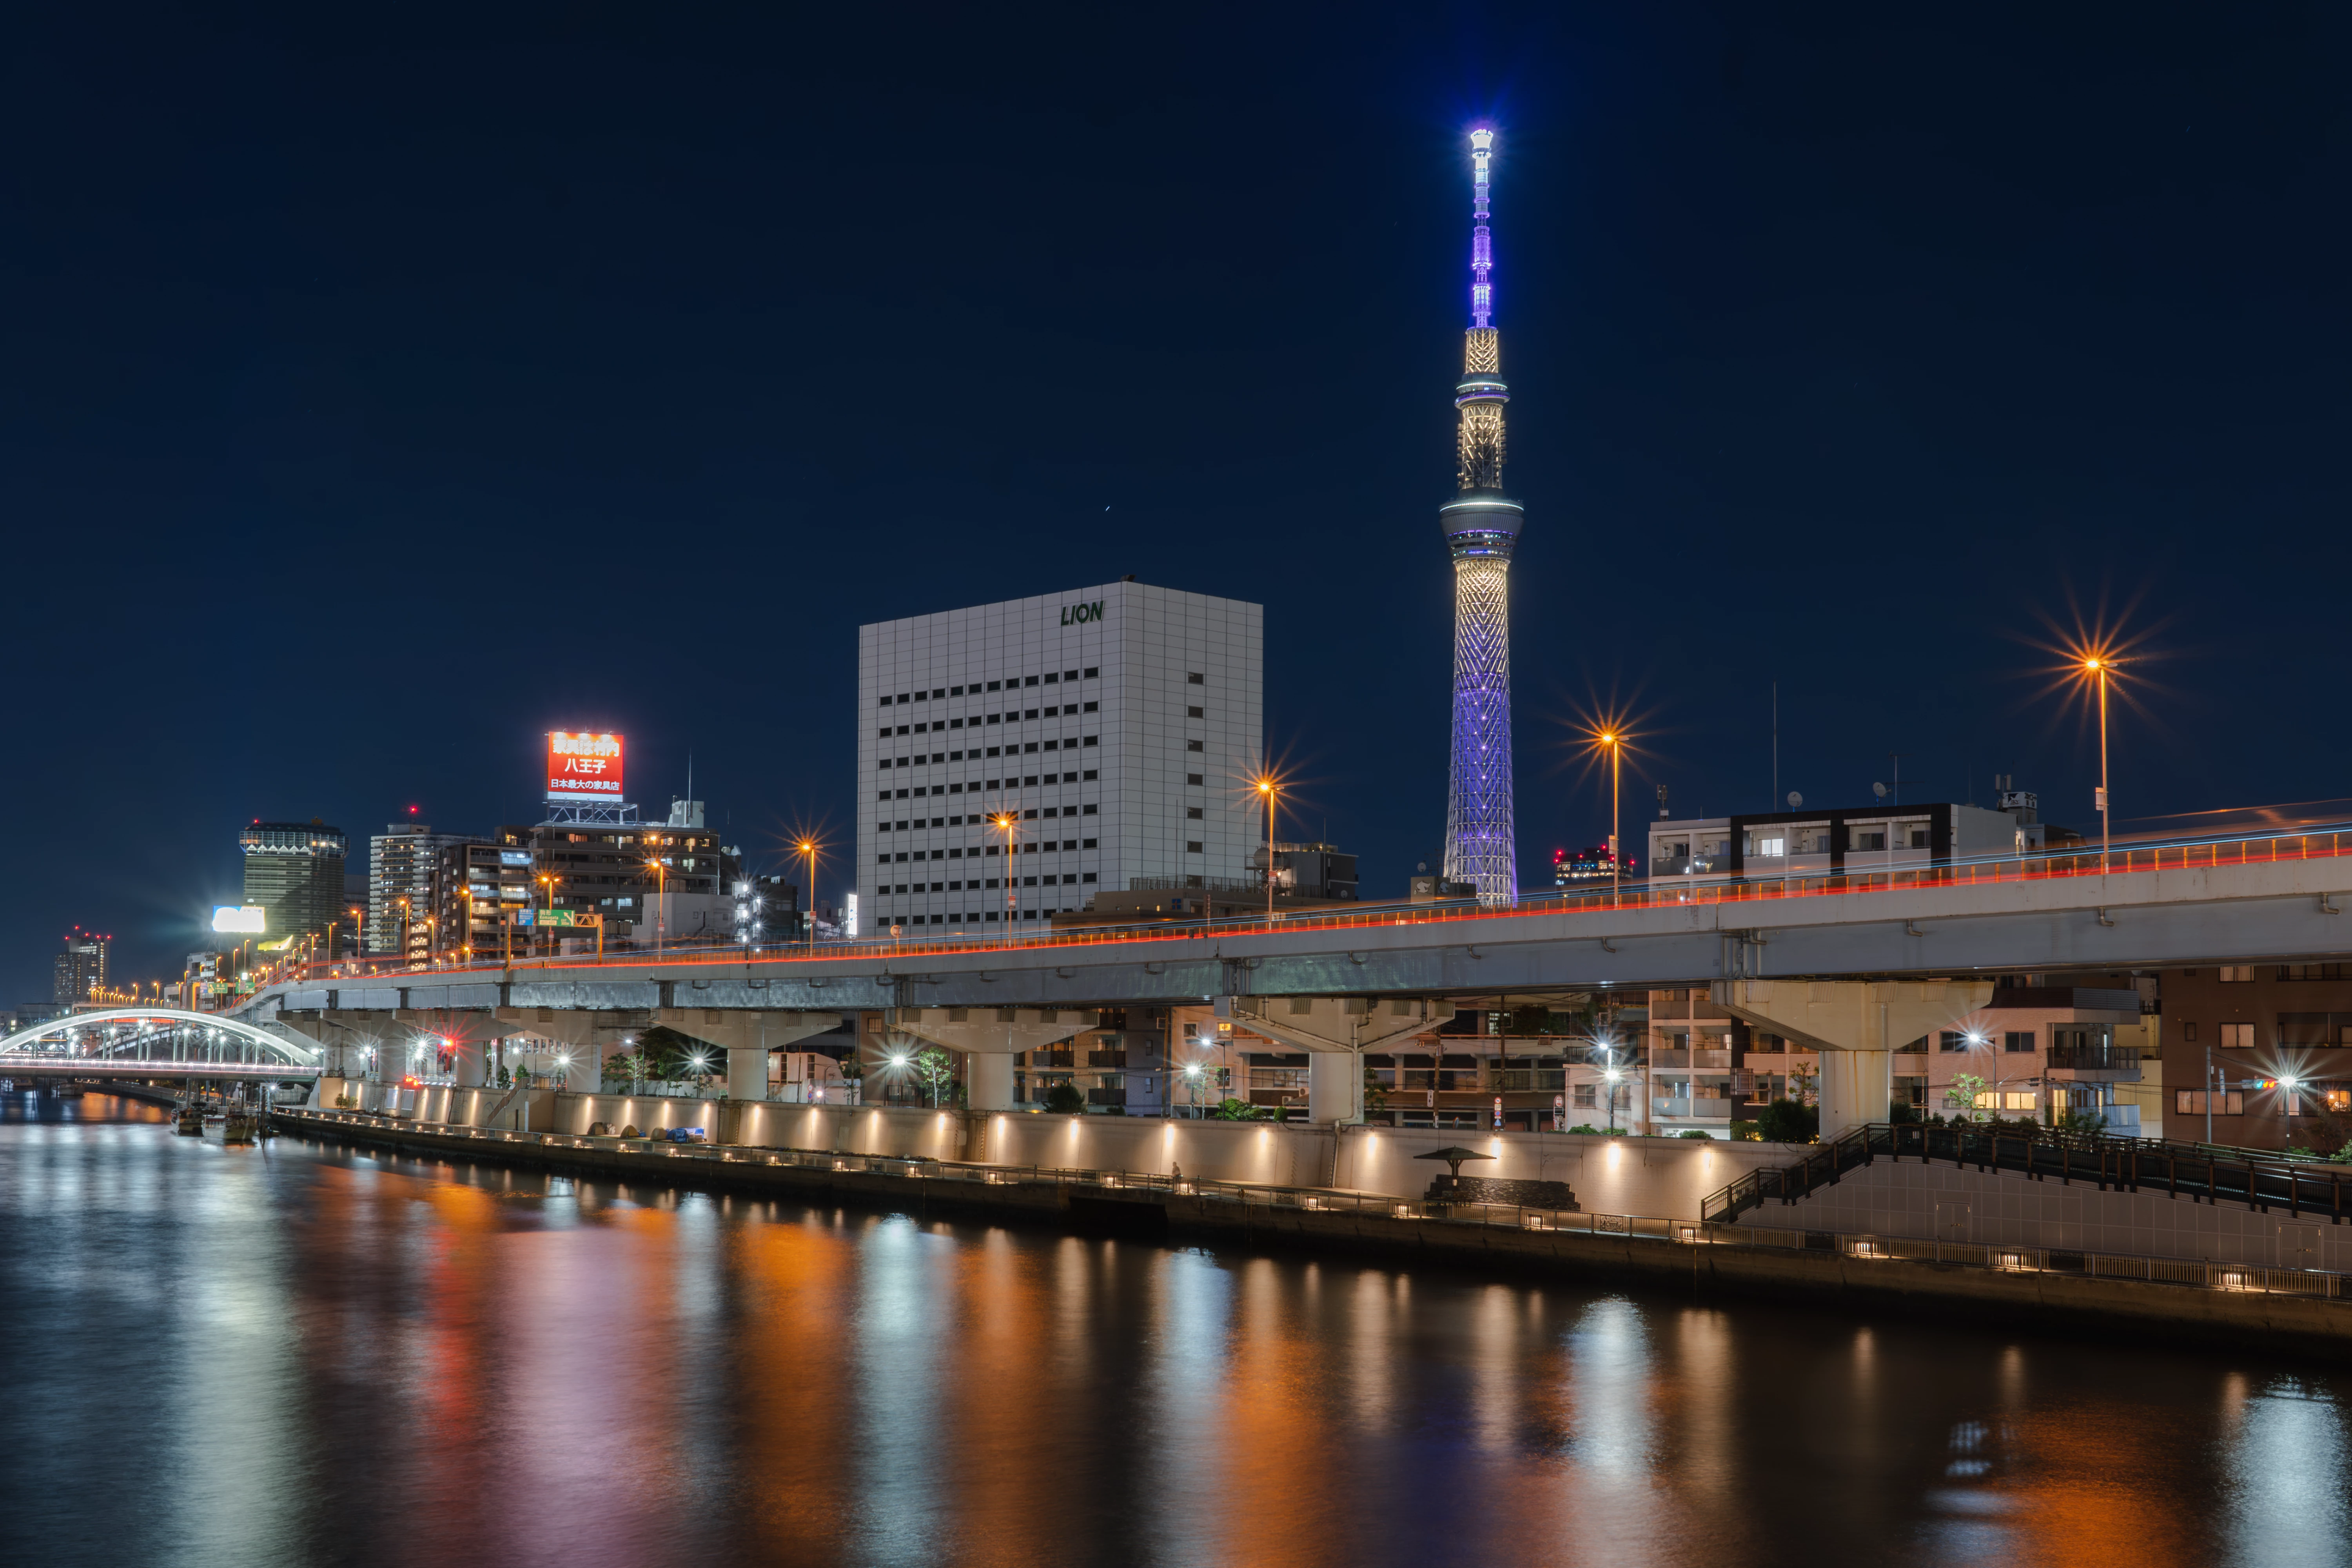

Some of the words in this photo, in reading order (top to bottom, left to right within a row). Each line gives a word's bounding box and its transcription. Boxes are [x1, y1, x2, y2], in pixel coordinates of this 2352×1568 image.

[1061, 601, 1104, 626] LION
[564, 758, 606, 774] 八王子
[551, 779, 620, 790] 日本最大の家具店
